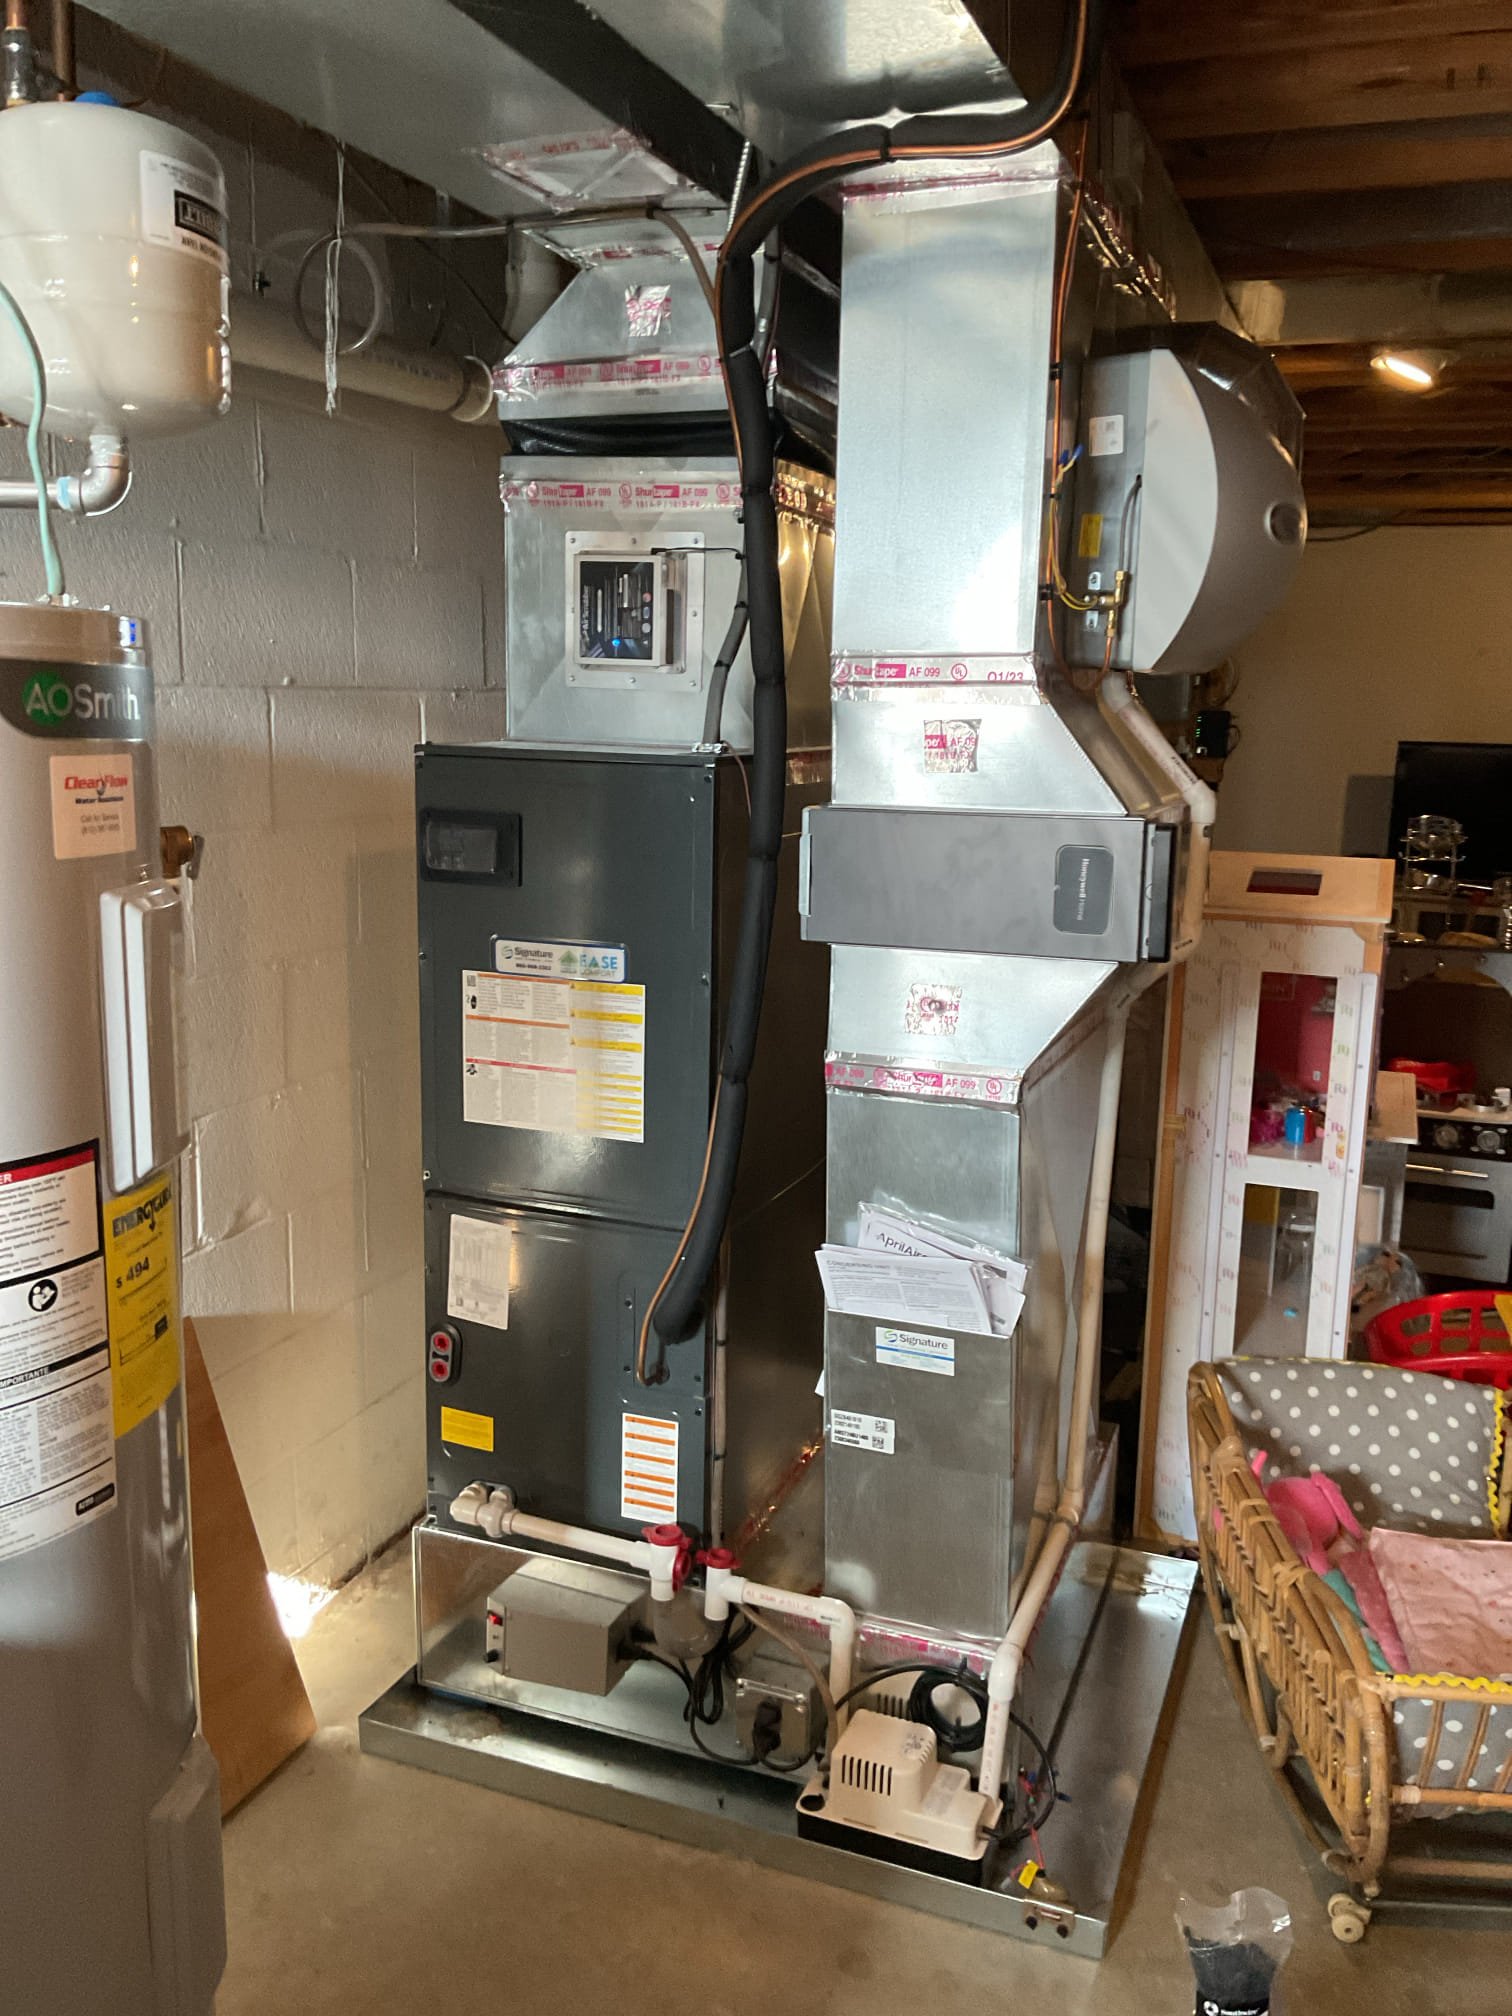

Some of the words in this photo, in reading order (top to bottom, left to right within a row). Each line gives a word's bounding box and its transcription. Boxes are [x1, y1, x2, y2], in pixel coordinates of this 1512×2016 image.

[586, 487, 598, 497] AF
[681, 487, 693, 497] AF
[909, 667, 921, 677] AF
[924, 667, 941, 678] 099
[1079, 858, 1090, 898] Honeywell
[514, 946, 554, 959] Signature
[945, 1078, 958, 1087] AF
[960, 1079, 976, 1090] 099
[126, 1256, 150, 1281] 494
[899, 1333, 949, 1350] Signature
[0, 1367, 49, 1387] MPORTANTE
